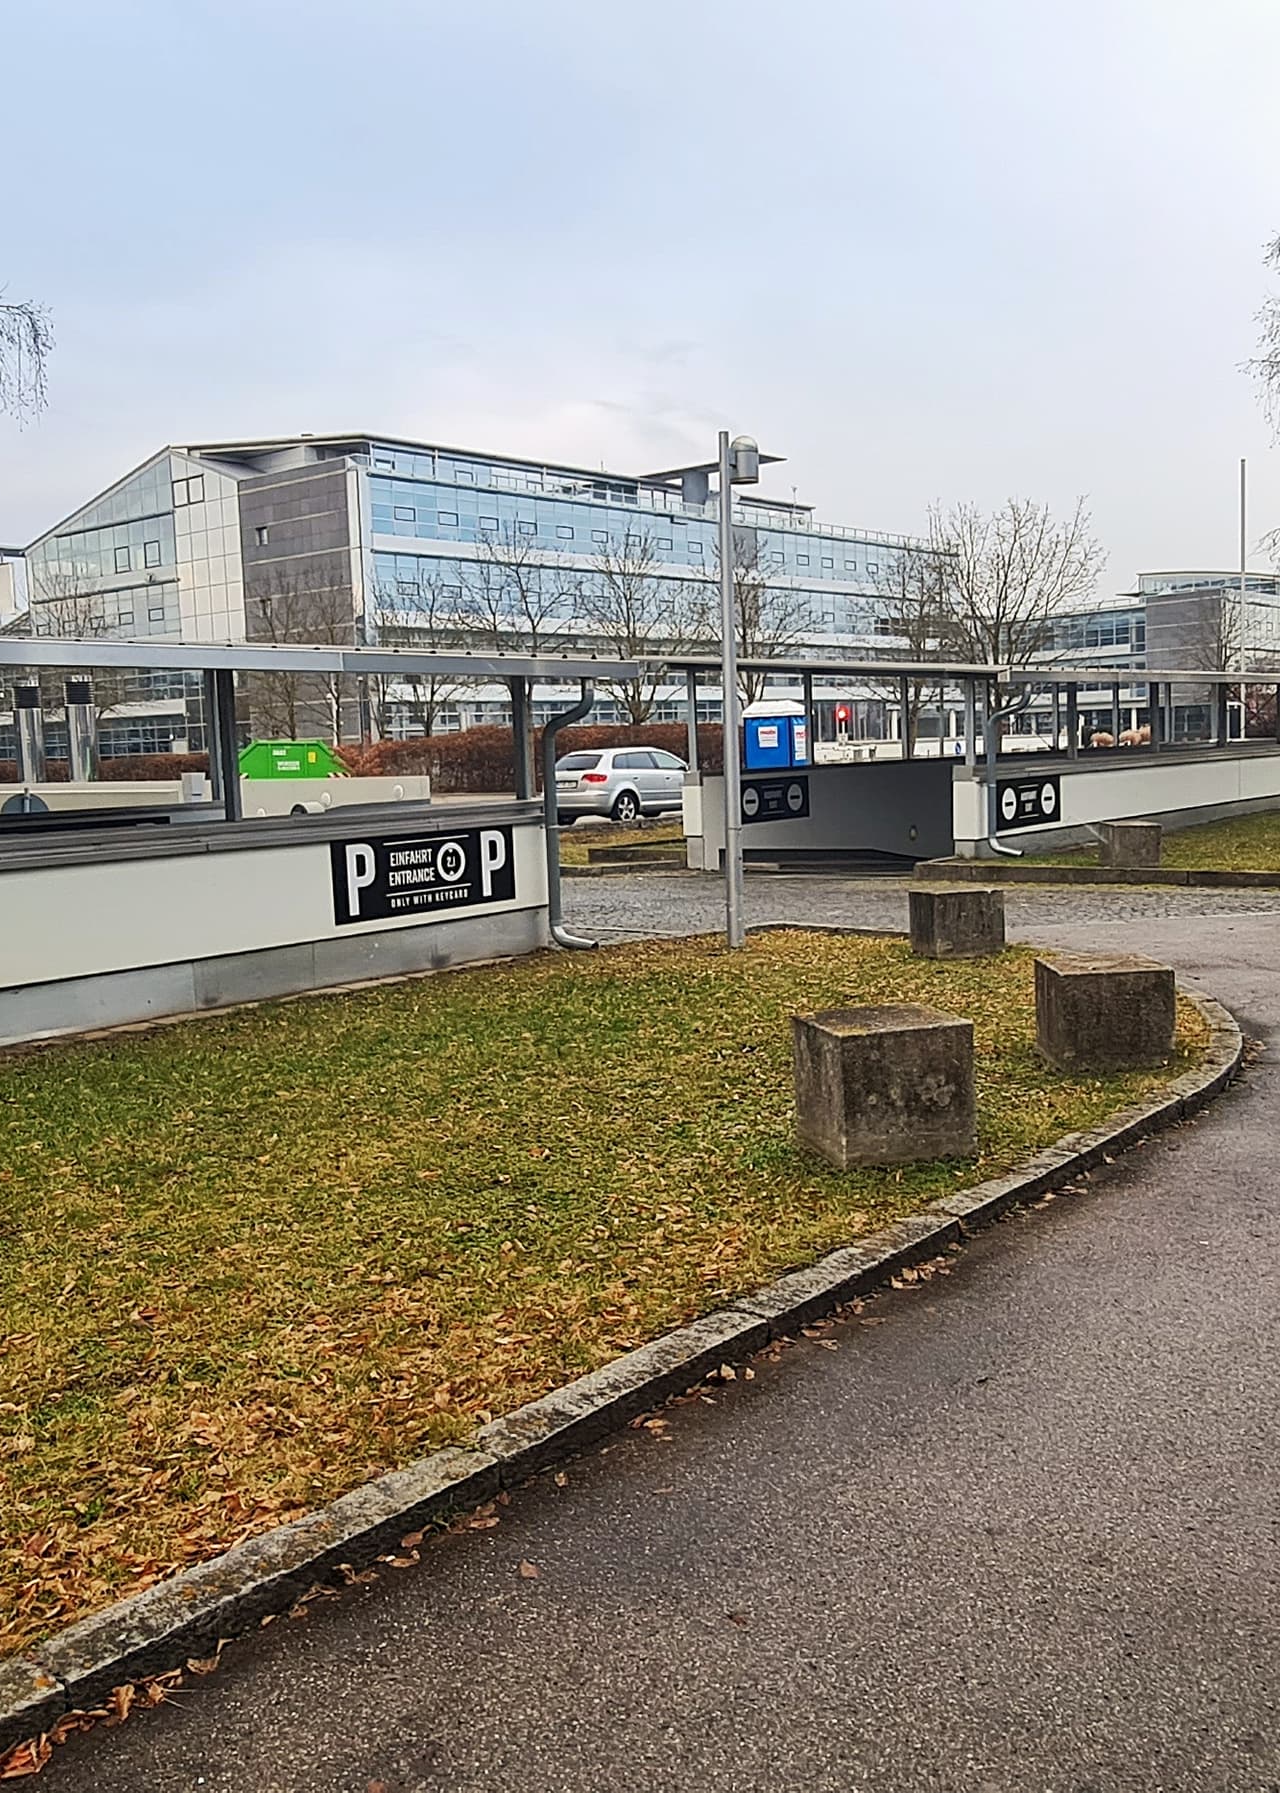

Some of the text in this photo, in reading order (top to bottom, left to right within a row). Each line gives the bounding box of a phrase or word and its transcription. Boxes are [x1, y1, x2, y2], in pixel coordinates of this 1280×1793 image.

[389, 848, 433, 867] EINFAHRT
[479, 829, 506, 897] P
[345, 843, 376, 917] P
[388, 867, 436, 887] ENTRANCE
[391, 888, 468, 908] ONLY WITH KEYCARD
